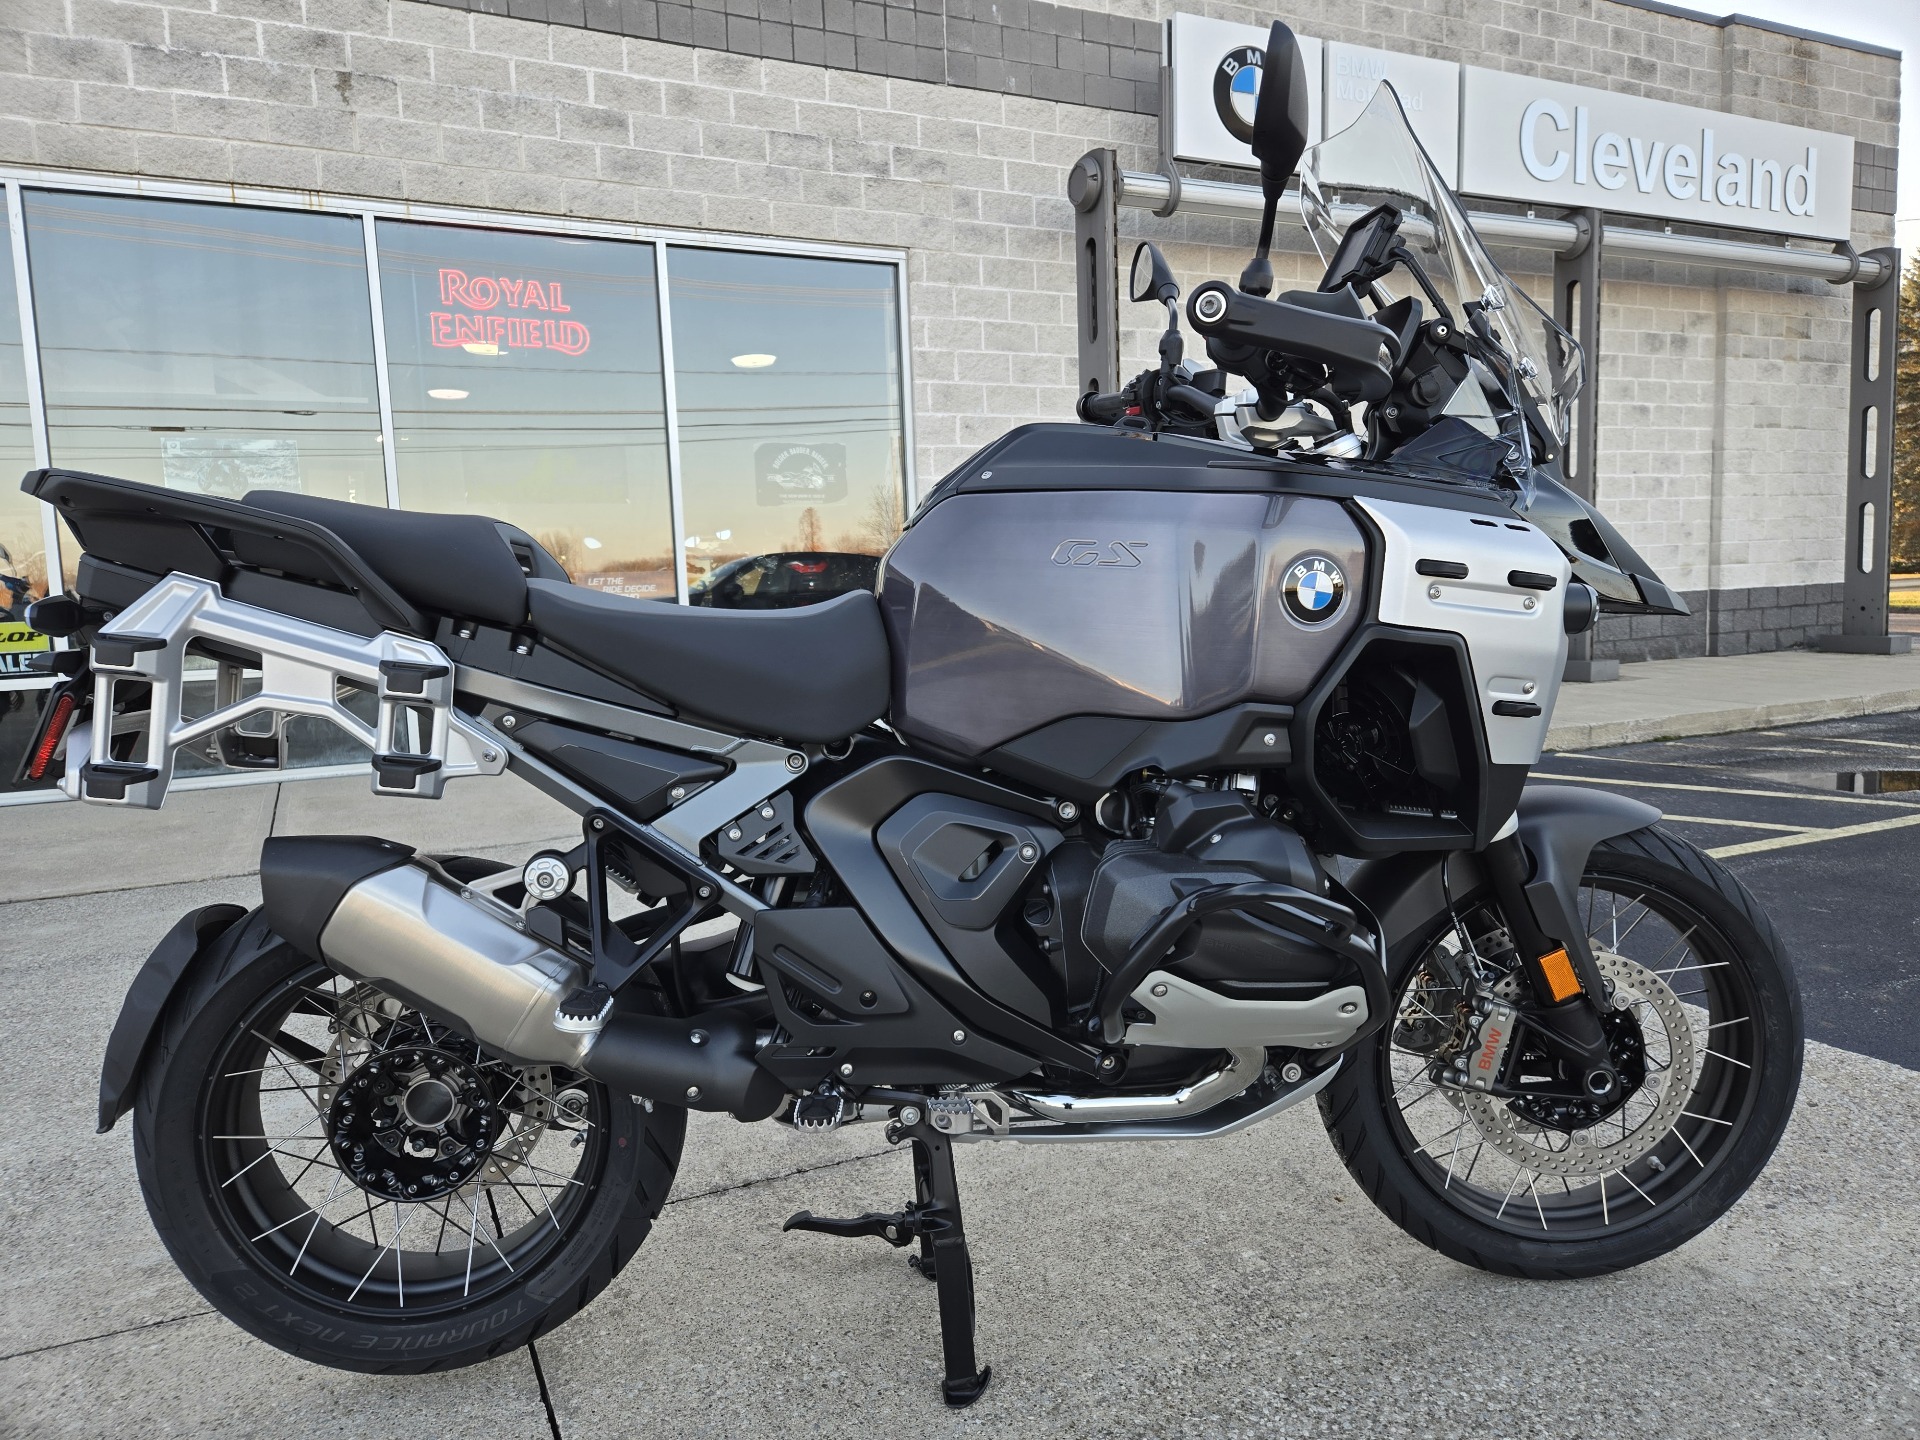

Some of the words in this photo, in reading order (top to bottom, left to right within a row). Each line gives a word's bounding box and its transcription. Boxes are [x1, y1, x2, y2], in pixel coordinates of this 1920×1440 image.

[1222, 49, 1262, 76] BM
[1335, 53, 1388, 80] BMW
[1519, 99, 1818, 217] Cleveland
[439, 269, 571, 312] ROYAL
[430, 312, 590, 356] ENFIELD
[1050, 538, 1149, 568] GS
[588, 577, 605, 586] LET
[606, 577, 624, 585] THE
[1294, 560, 1342, 584] BMW
[602, 585, 623, 593] RIDE
[1477, 1027, 1503, 1071] BMW
[233, 1282, 259, 1300] 2
[351, 1300, 527, 1351] TOURANCE
